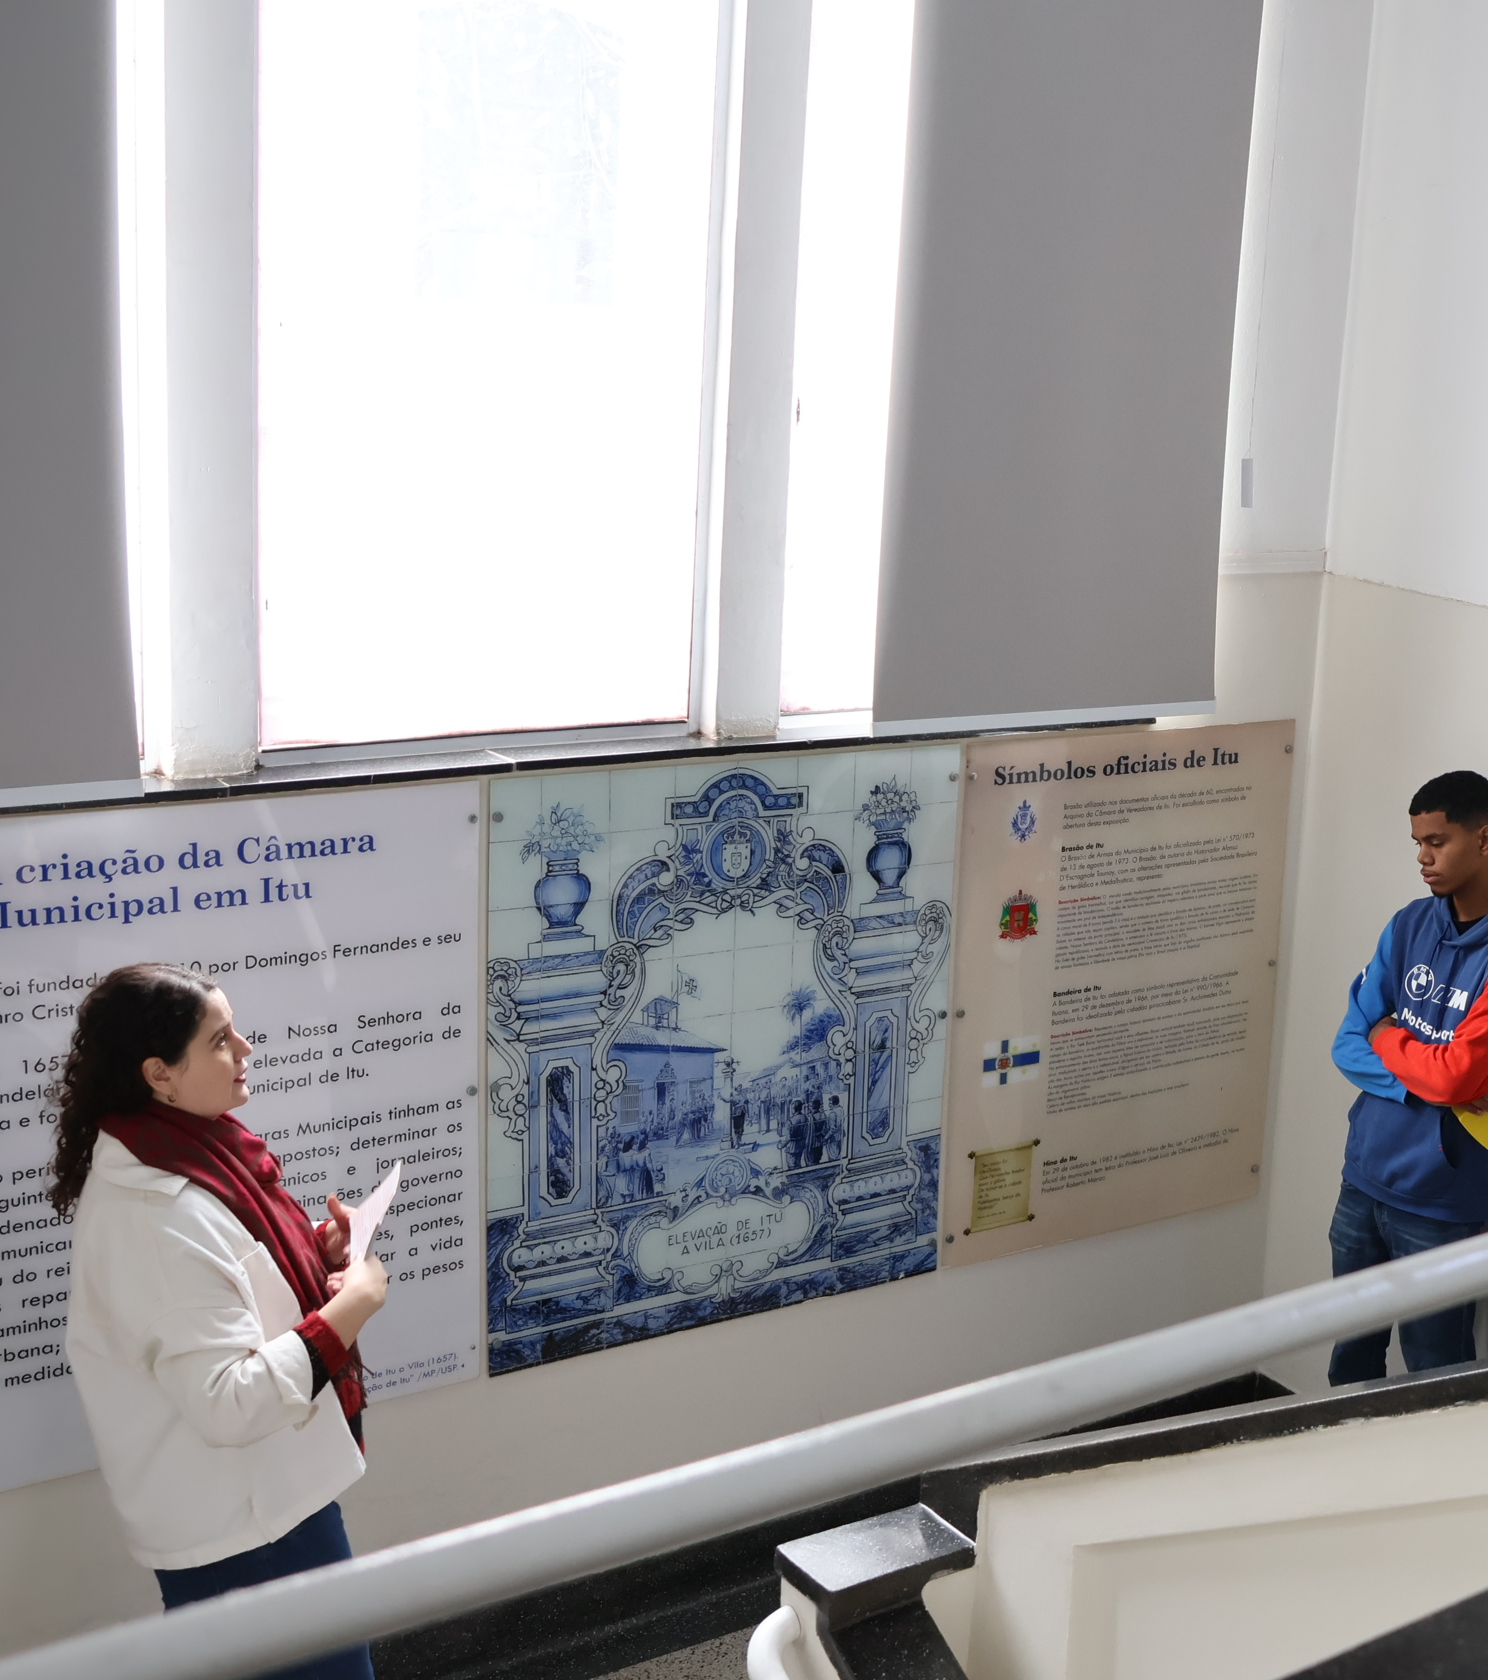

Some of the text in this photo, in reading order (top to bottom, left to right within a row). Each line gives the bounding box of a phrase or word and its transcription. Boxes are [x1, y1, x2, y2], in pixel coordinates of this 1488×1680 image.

[994, 747, 1239, 787] Símbolos oficiais de Itu
[15, 832, 376, 884] criação da Câmara
[1061, 845, 1084, 853] Brasão
[194, 885, 248, 911] em
[260, 876, 313, 904] Itu
[209, 959, 239, 977] por
[245, 948, 327, 971] Domingos
[332, 937, 417, 959] Fernandes
[422, 935, 431, 947] e
[437, 931, 462, 945] seu
[1053, 989, 1082, 998] Bandeira
[246, 1031, 267, 1045] de
[288, 1021, 338, 1039] Nossa
[358, 1009, 423, 1029] Senhora
[441, 1003, 462, 1017] da
[253, 1048, 324, 1070] elevada
[333, 1047, 343, 1058] a
[351, 1030, 433, 1054] Categoria
[441, 1026, 462, 1041] de
[19, 1117, 30, 1128] e
[38, 1110, 58, 1125] fo
[319, 1070, 340, 1085] de
[346, 1066, 370, 1080] Itu.
[296, 1112, 382, 1137] Municipais
[388, 1102, 439, 1121] tinham
[445, 1098, 462, 1110] as
[350, 1126, 437, 1151] determinar
[446, 1121, 463, 1134] os
[347, 1165, 356, 1176] e
[375, 1145, 463, 1174] jornaleiros;
[400, 1168, 463, 1193] governo
[408, 1246, 418, 1258] a
[430, 1235, 463, 1252] vida
[667, 1221, 728, 1247] ELEVAÇÃO
[736, 1218, 751, 1232] DE
[681, 1227, 772, 1256] A VILA (1657)
[12, 1269, 37, 1285] do
[21, 1291, 72, 1310] repa
[409, 1214, 463, 1237] pontes,
[0, 1344, 60, 1362] bana;
[399, 1269, 415, 1282] os
[421, 1259, 464, 1281] pesos
[385, 1368, 396, 1376] Itu
[407, 1361, 425, 1370] Vila
[427, 1352, 459, 1368] (1657).
[385, 1379, 397, 1388] de
